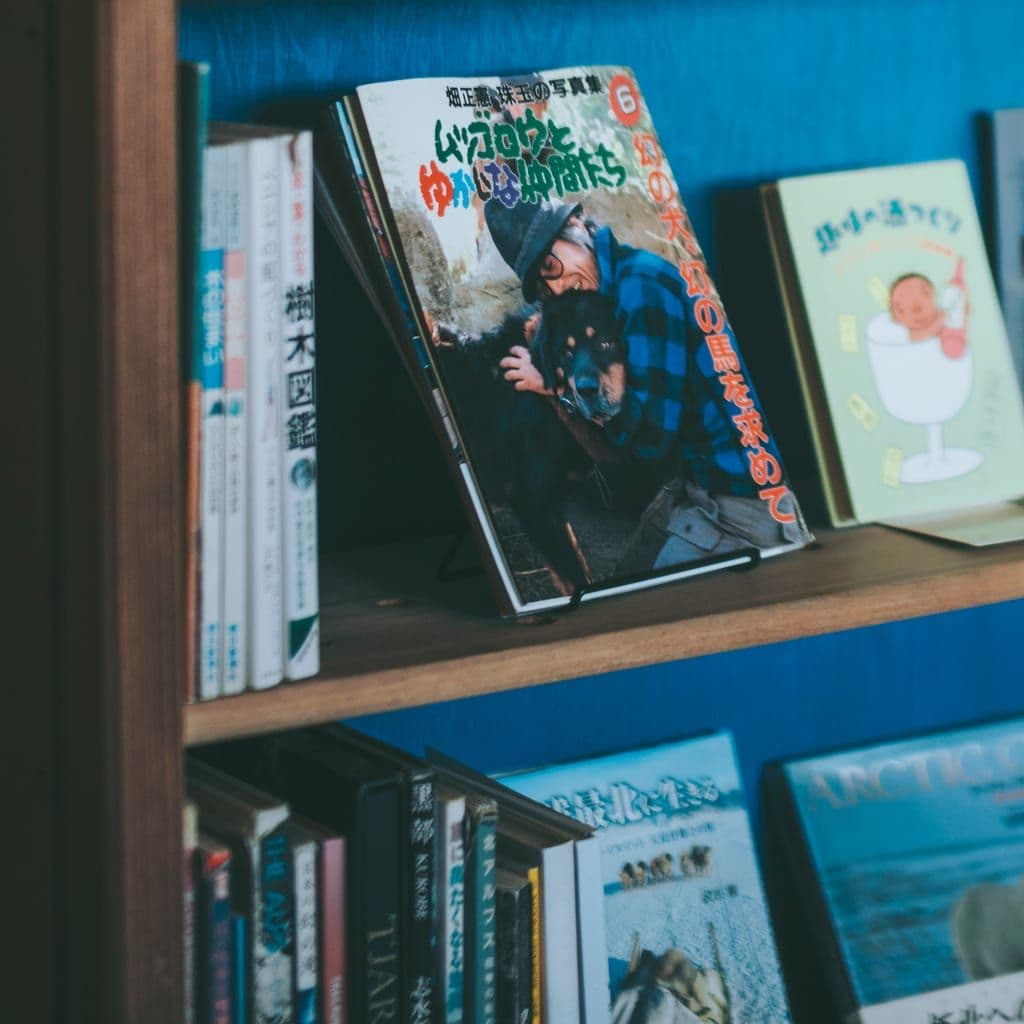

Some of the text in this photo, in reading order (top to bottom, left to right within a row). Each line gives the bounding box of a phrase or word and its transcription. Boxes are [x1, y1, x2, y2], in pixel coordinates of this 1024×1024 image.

[434, 107, 576, 165] ムツゴロウと
[620, 84, 637, 115] 6
[419, 143, 628, 217] ゆかいな仲間たち
[284, 282, 317, 451] 樹木図鑑
[482, 832, 497, 952] 北アルプス
